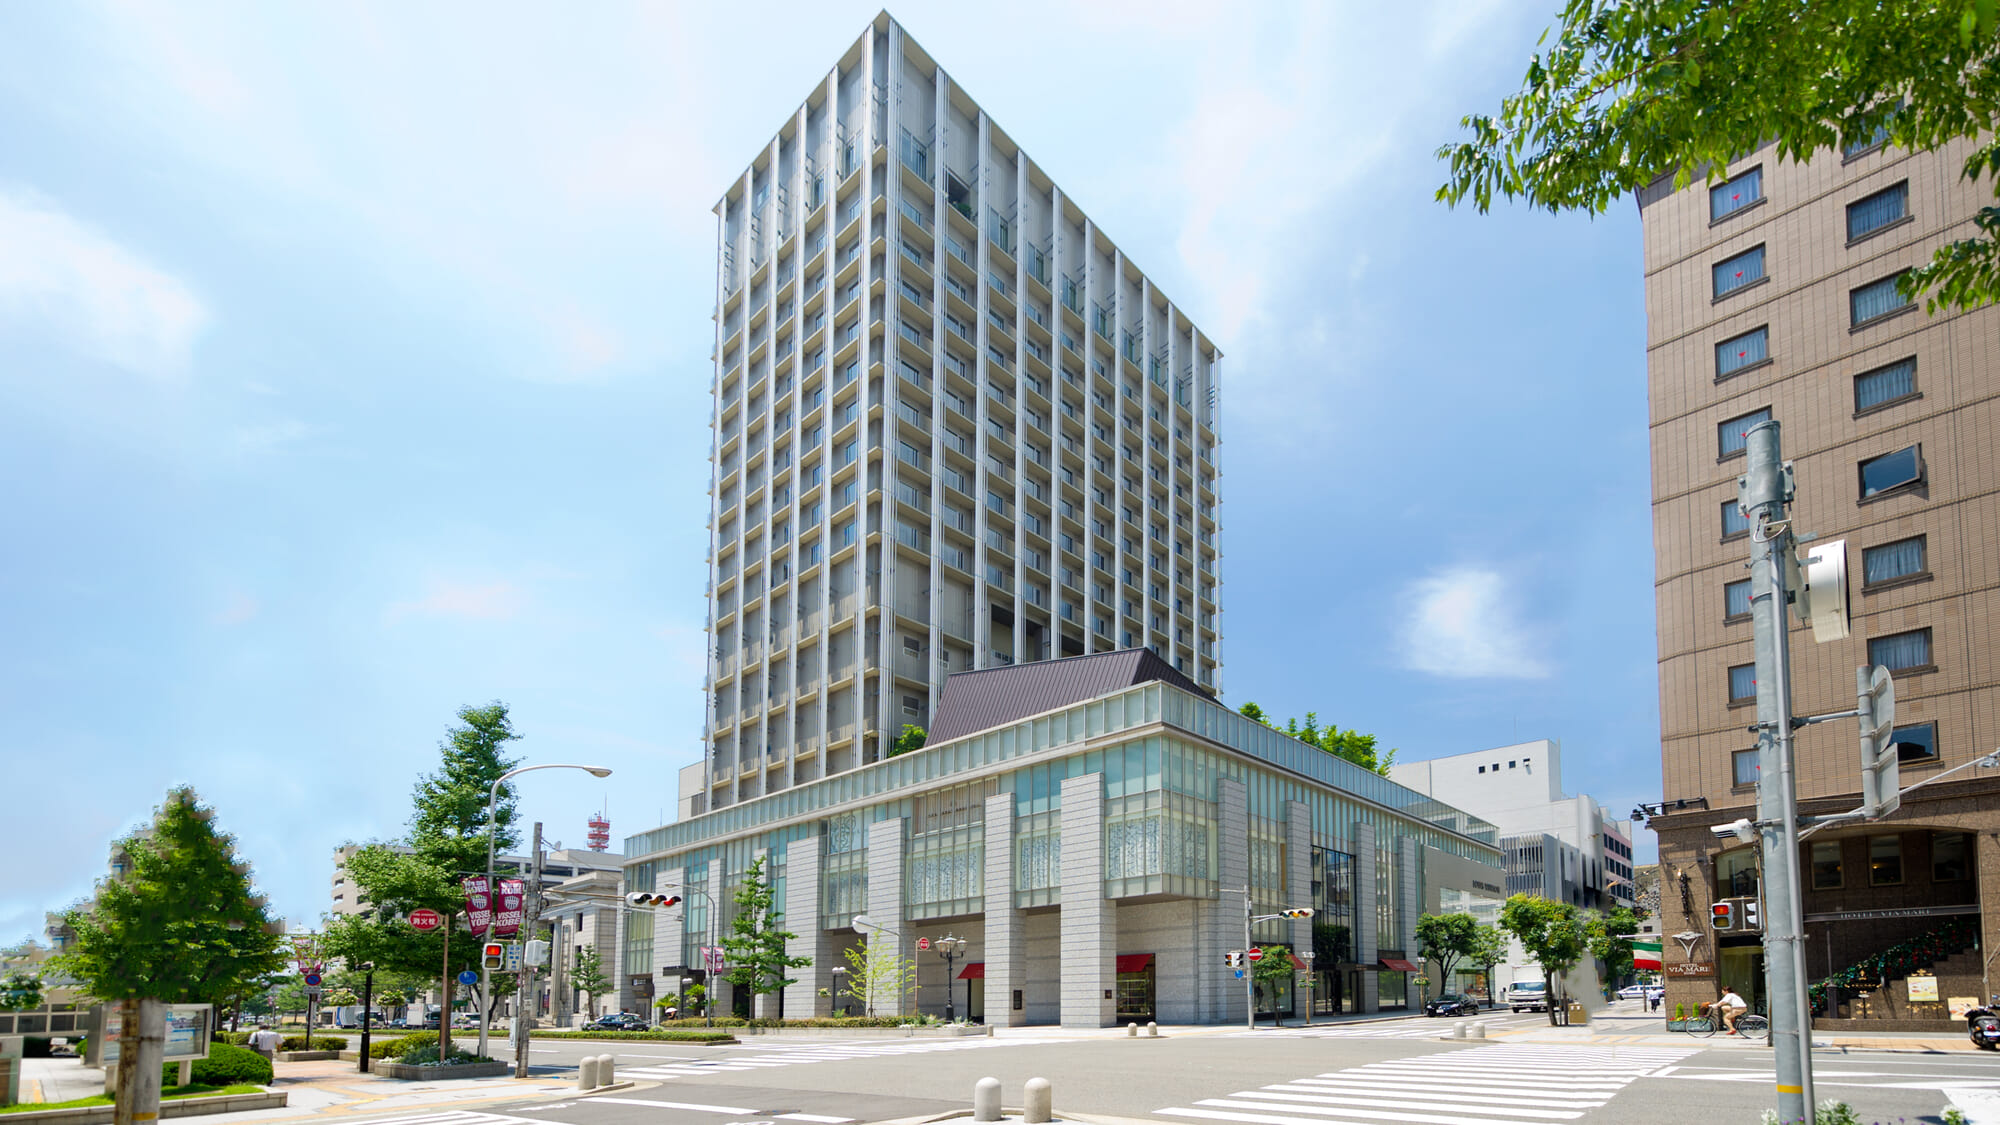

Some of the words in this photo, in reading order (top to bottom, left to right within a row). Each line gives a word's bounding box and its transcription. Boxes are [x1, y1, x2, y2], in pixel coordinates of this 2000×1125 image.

[469, 910, 490, 919] VISSEL
[498, 911, 520, 919] VISSEL
[496, 918, 520, 927] KOBE
